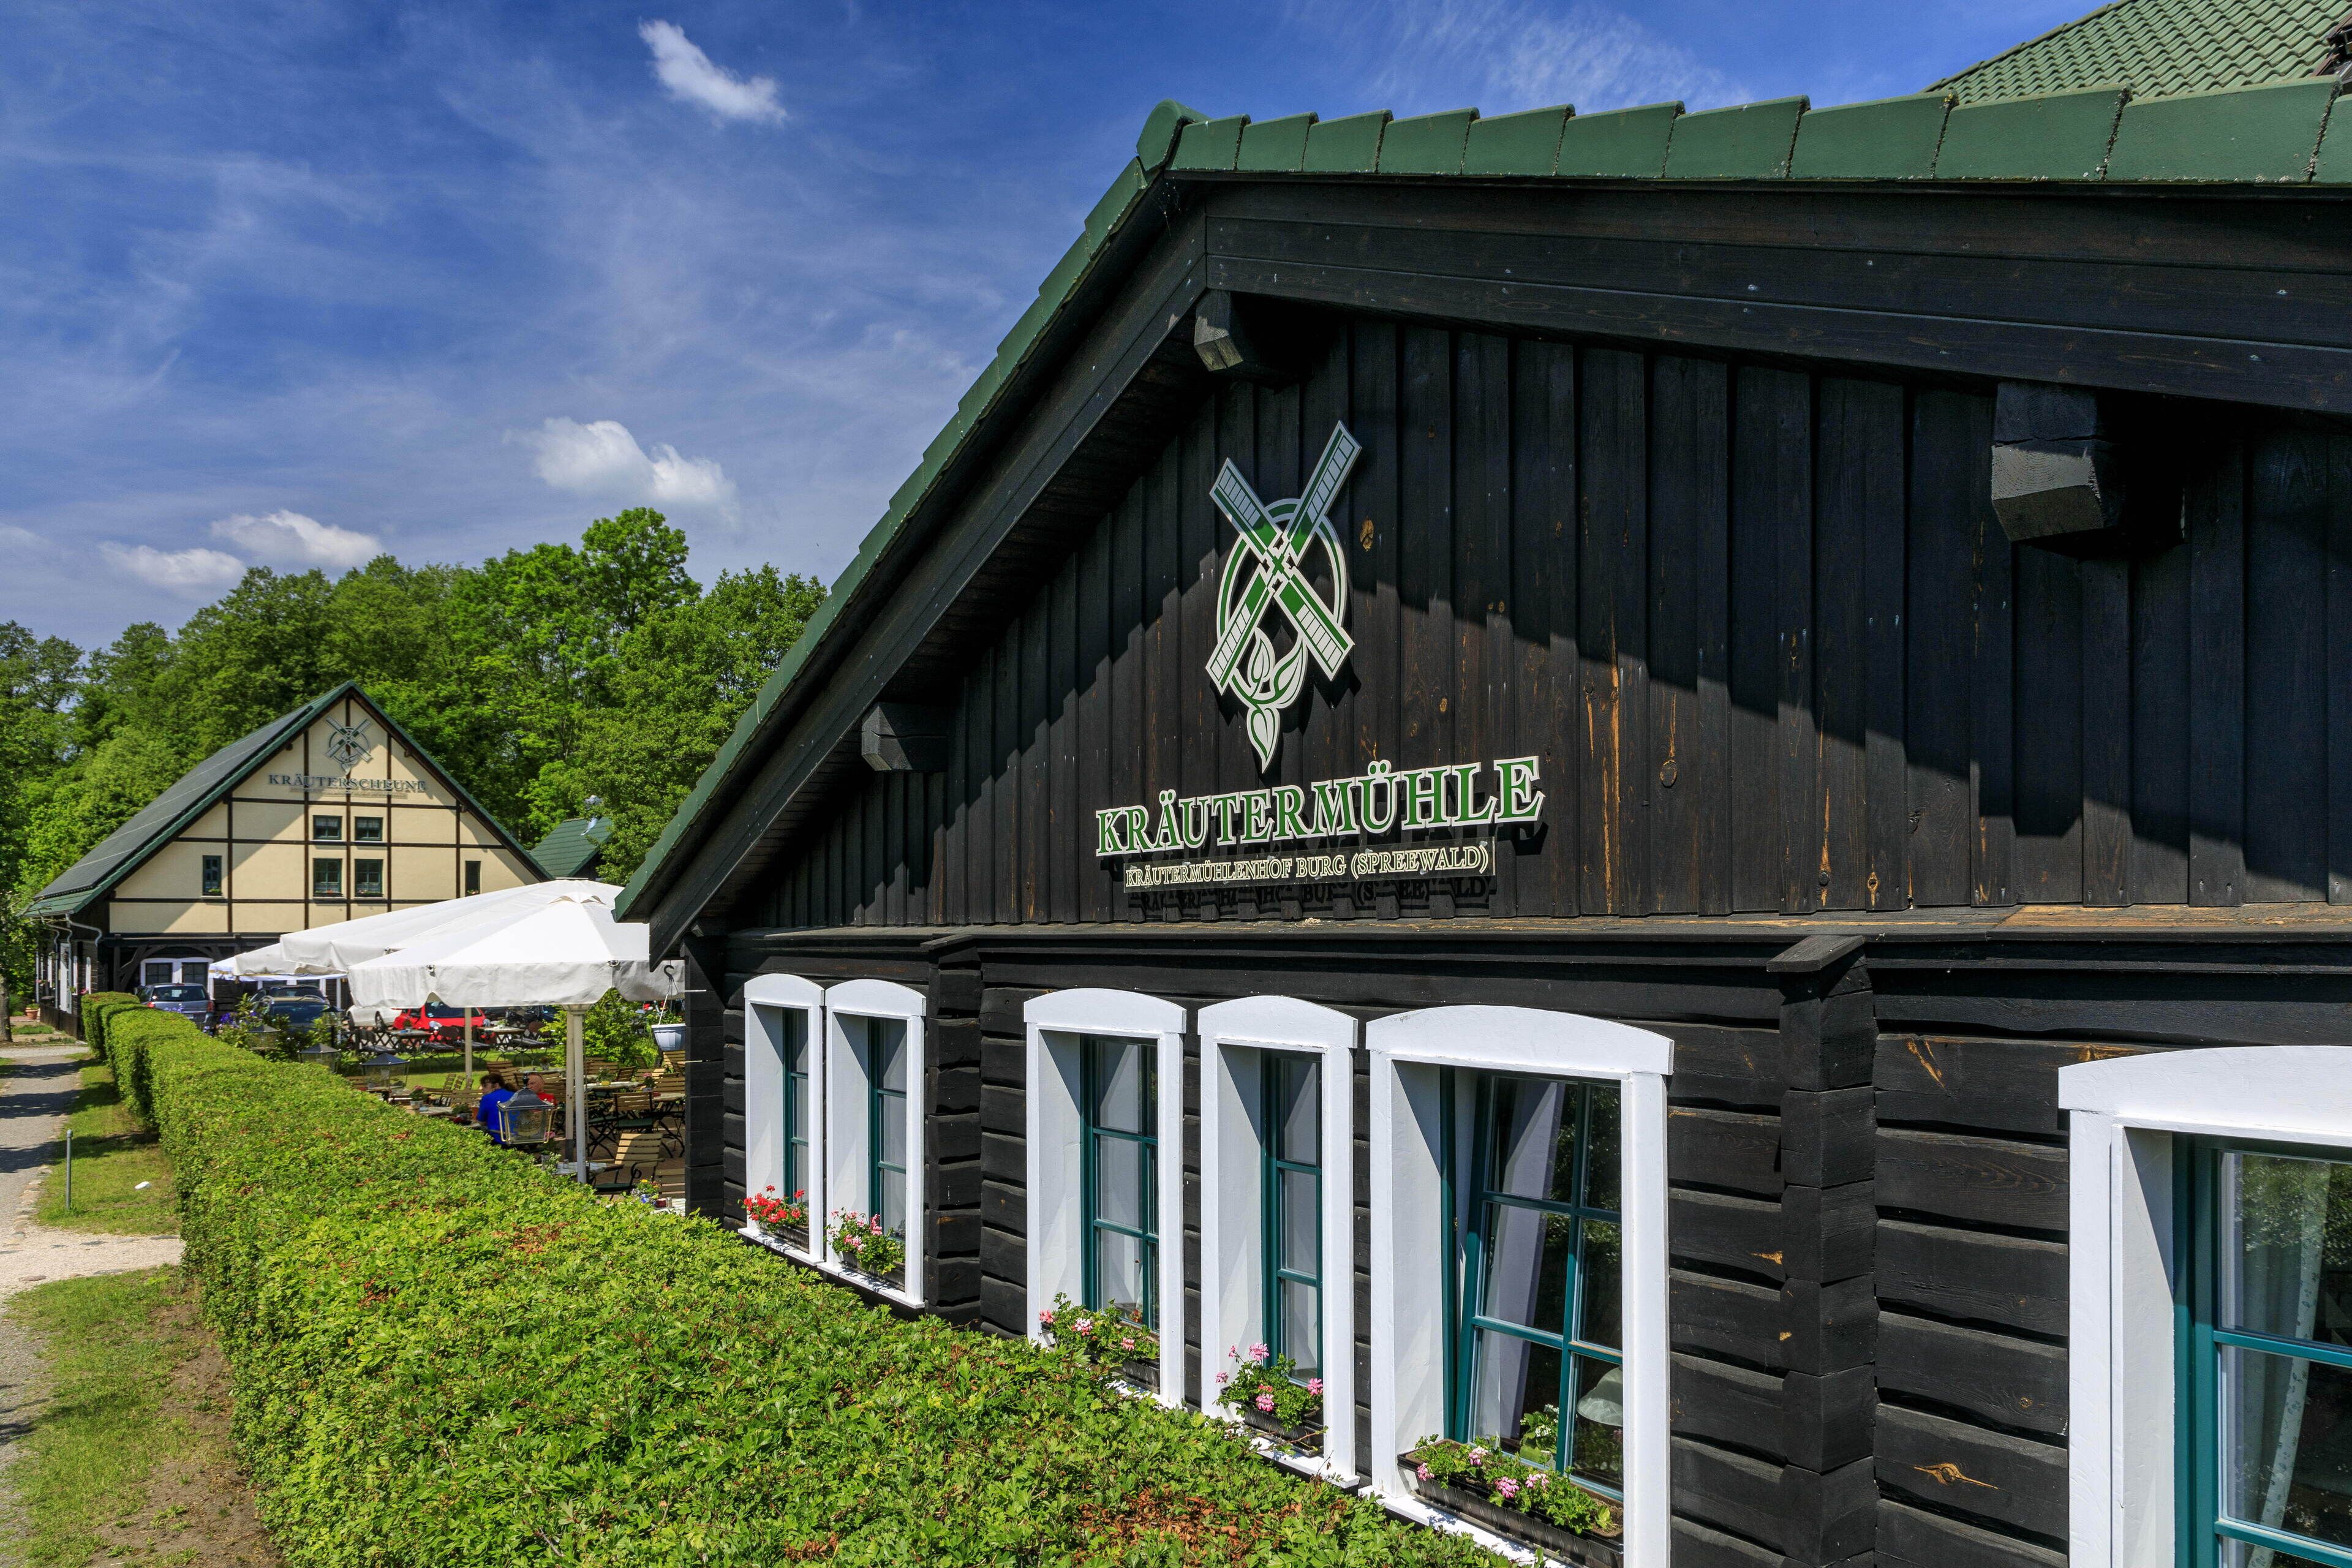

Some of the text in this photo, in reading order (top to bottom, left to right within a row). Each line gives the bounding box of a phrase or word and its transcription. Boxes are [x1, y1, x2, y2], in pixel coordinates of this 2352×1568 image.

[268, 774, 426, 791] KRÄUTERSCHEUNE
[1096, 755, 1546, 856] KRÄUTERMÜHLE
[1126, 845, 1489, 887] KRÄUTERMÜHLENHOF BURG (SPREEWALD)
